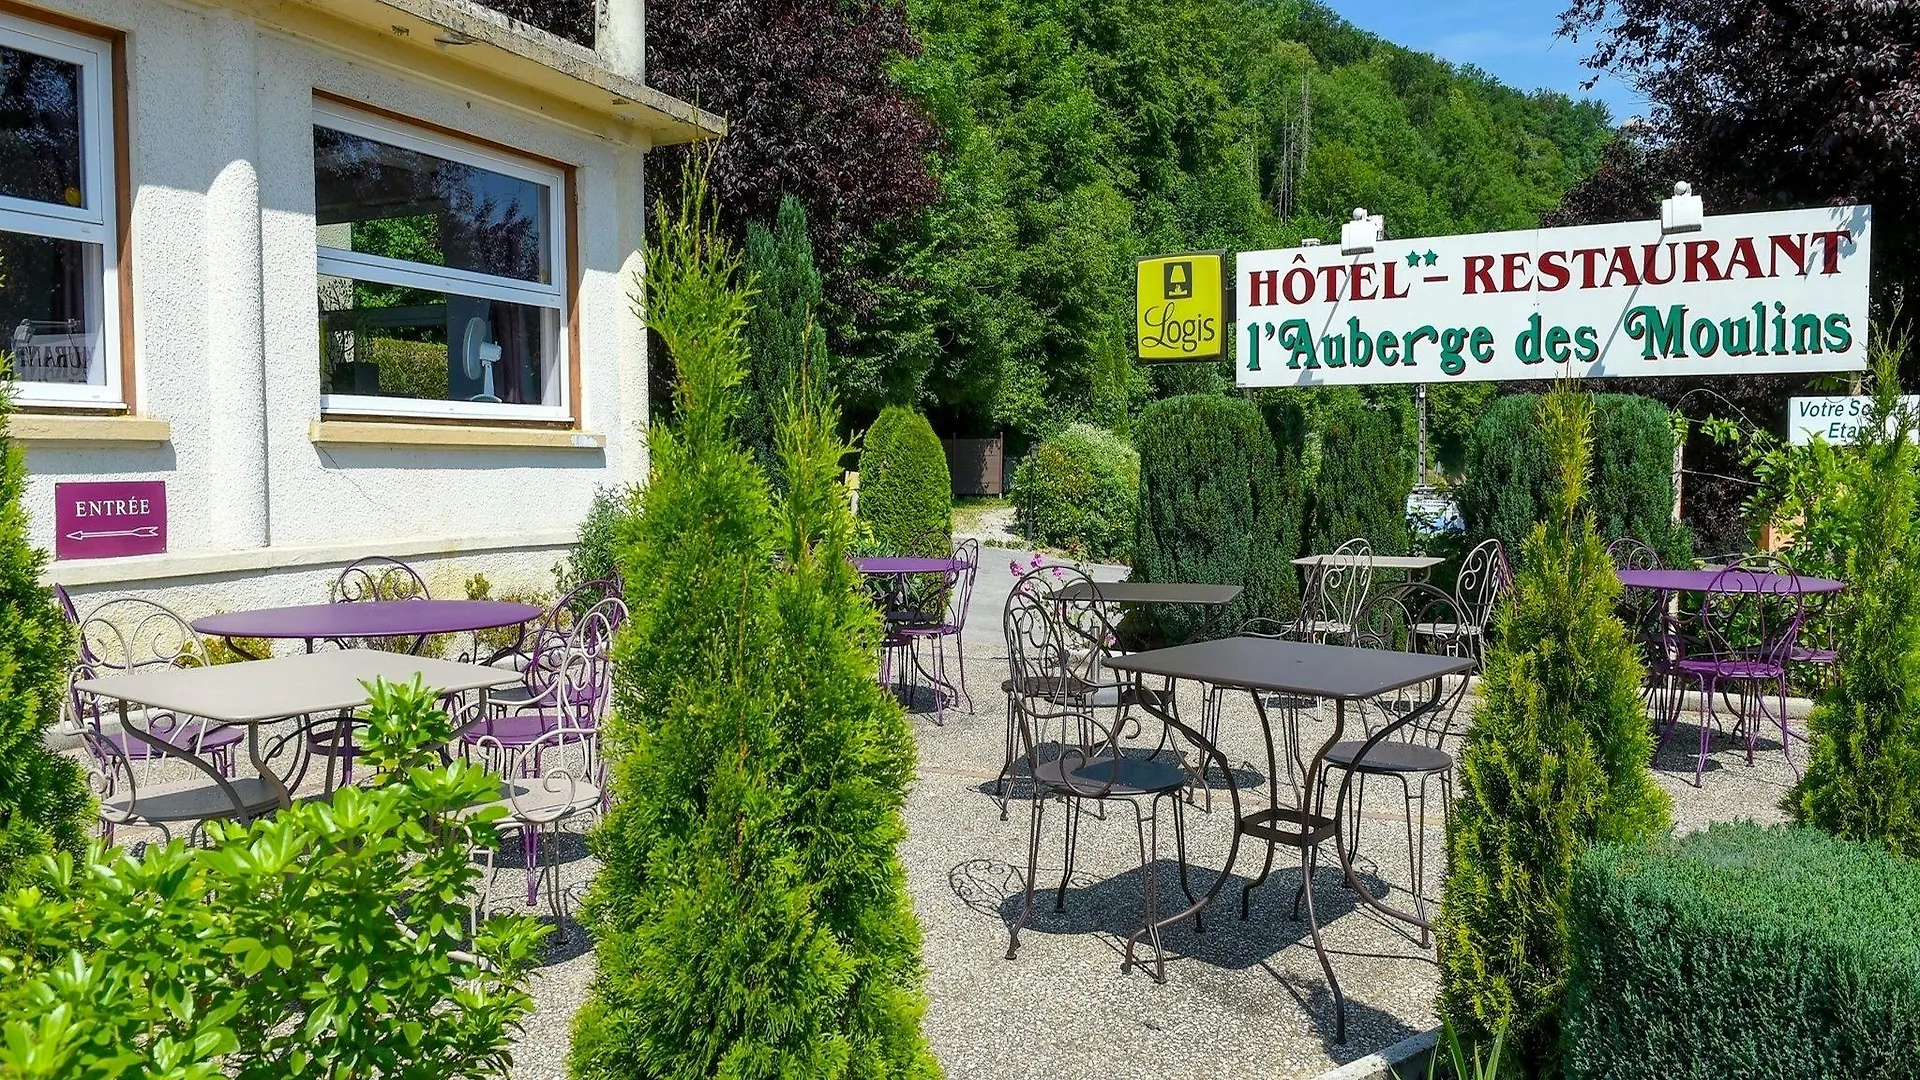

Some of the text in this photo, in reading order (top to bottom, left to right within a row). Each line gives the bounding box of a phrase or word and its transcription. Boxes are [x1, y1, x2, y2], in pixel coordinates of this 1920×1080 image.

[1248, 254, 1411, 307] HÔTEL
[1461, 230, 1852, 295] RESTAURANT
[1141, 301, 1215, 353] Logis
[1246, 300, 1853, 376] l'Auberge des Moulins
[1799, 400, 1845, 418] Votre
[75, 495, 151, 518] ENTRÉE
